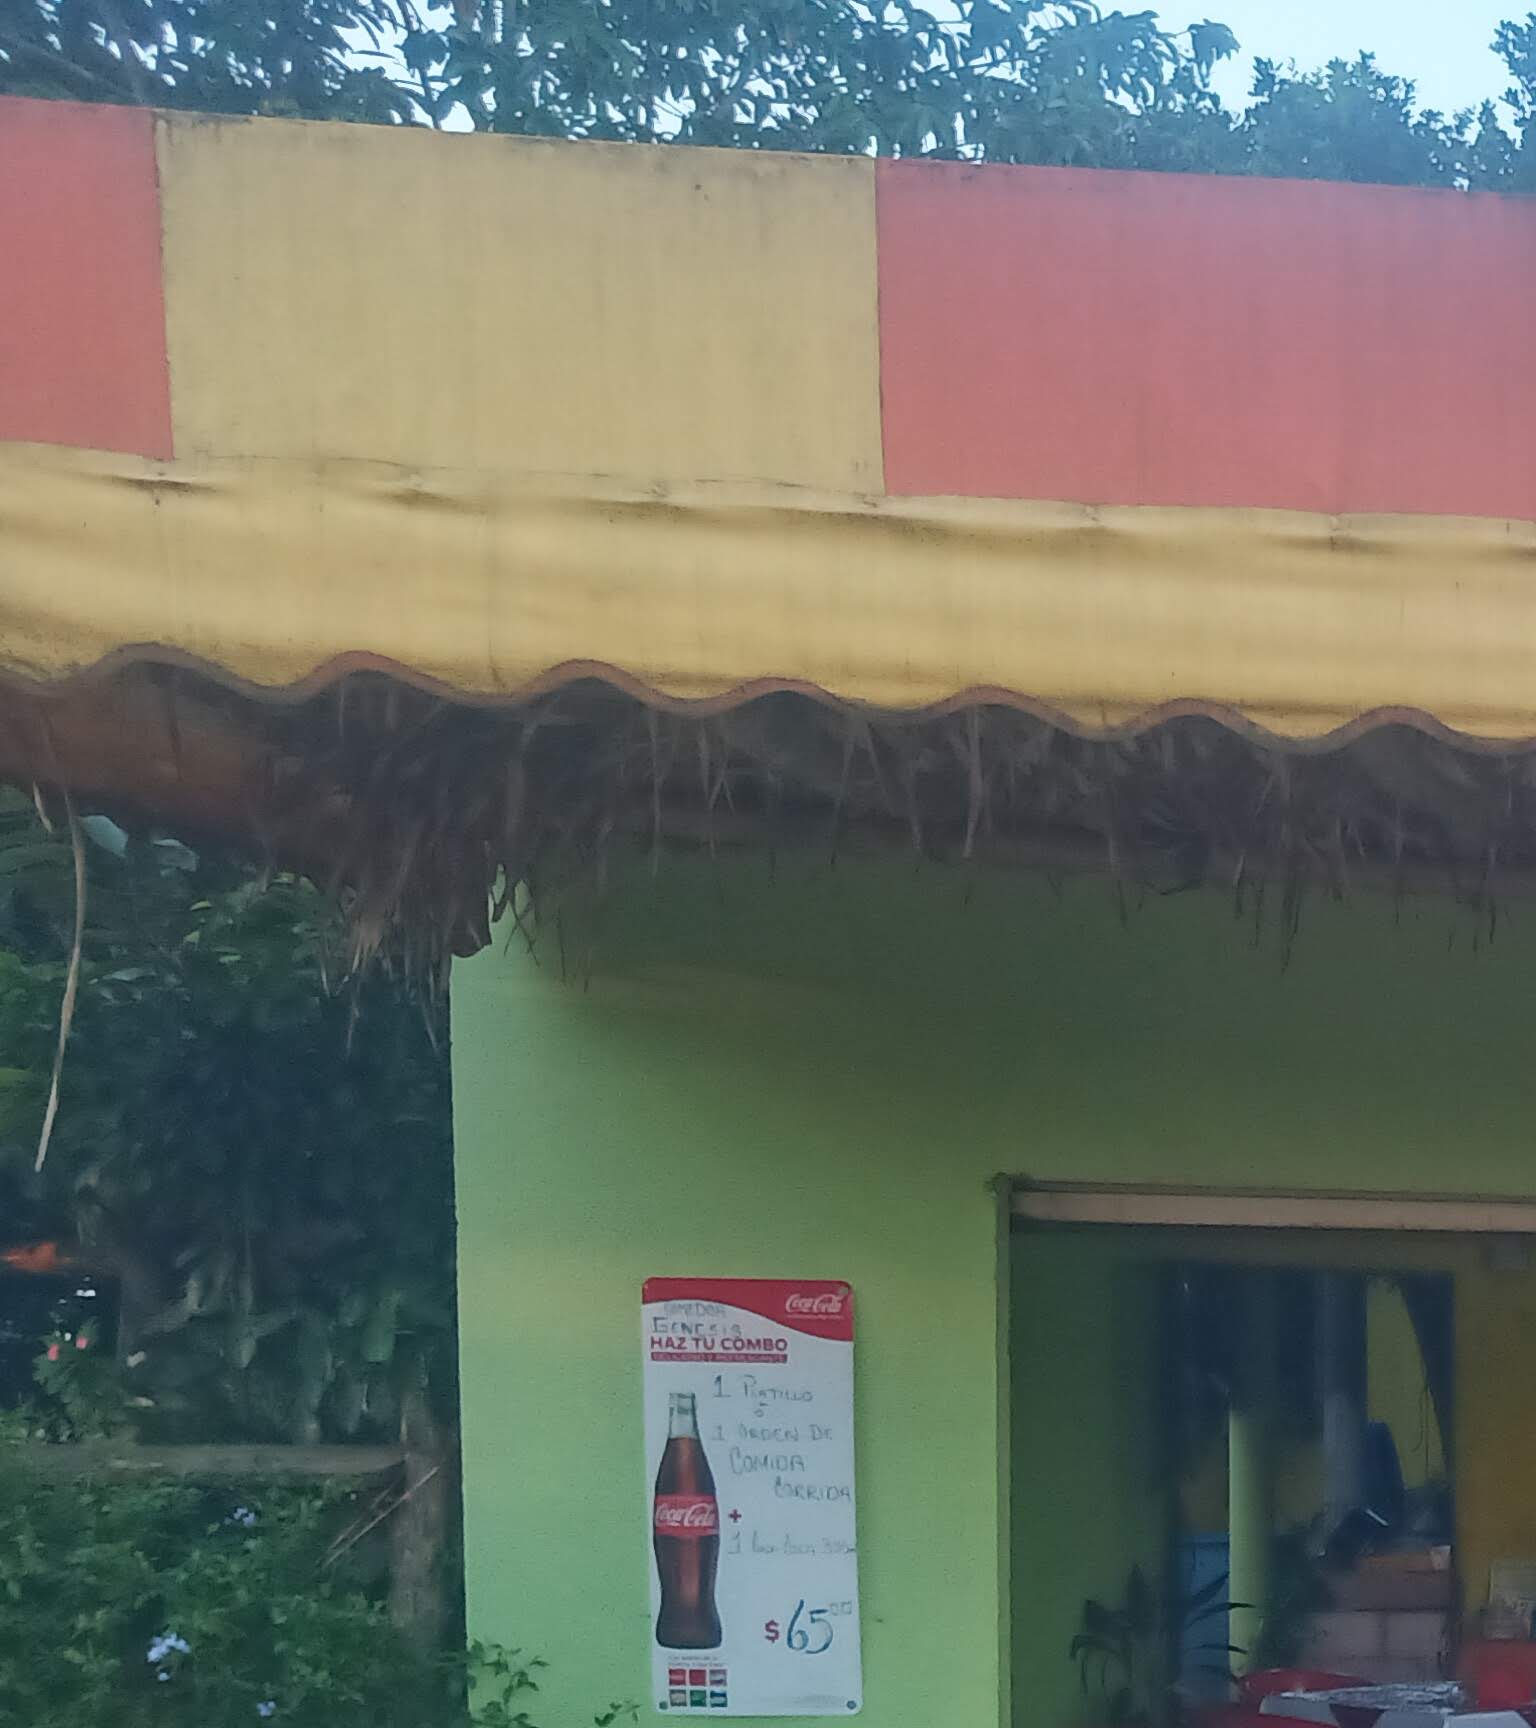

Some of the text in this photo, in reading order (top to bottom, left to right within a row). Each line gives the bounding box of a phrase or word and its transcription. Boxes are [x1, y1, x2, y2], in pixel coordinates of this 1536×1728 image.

[650, 1336, 788, 1351] HAZ TU COMBO
